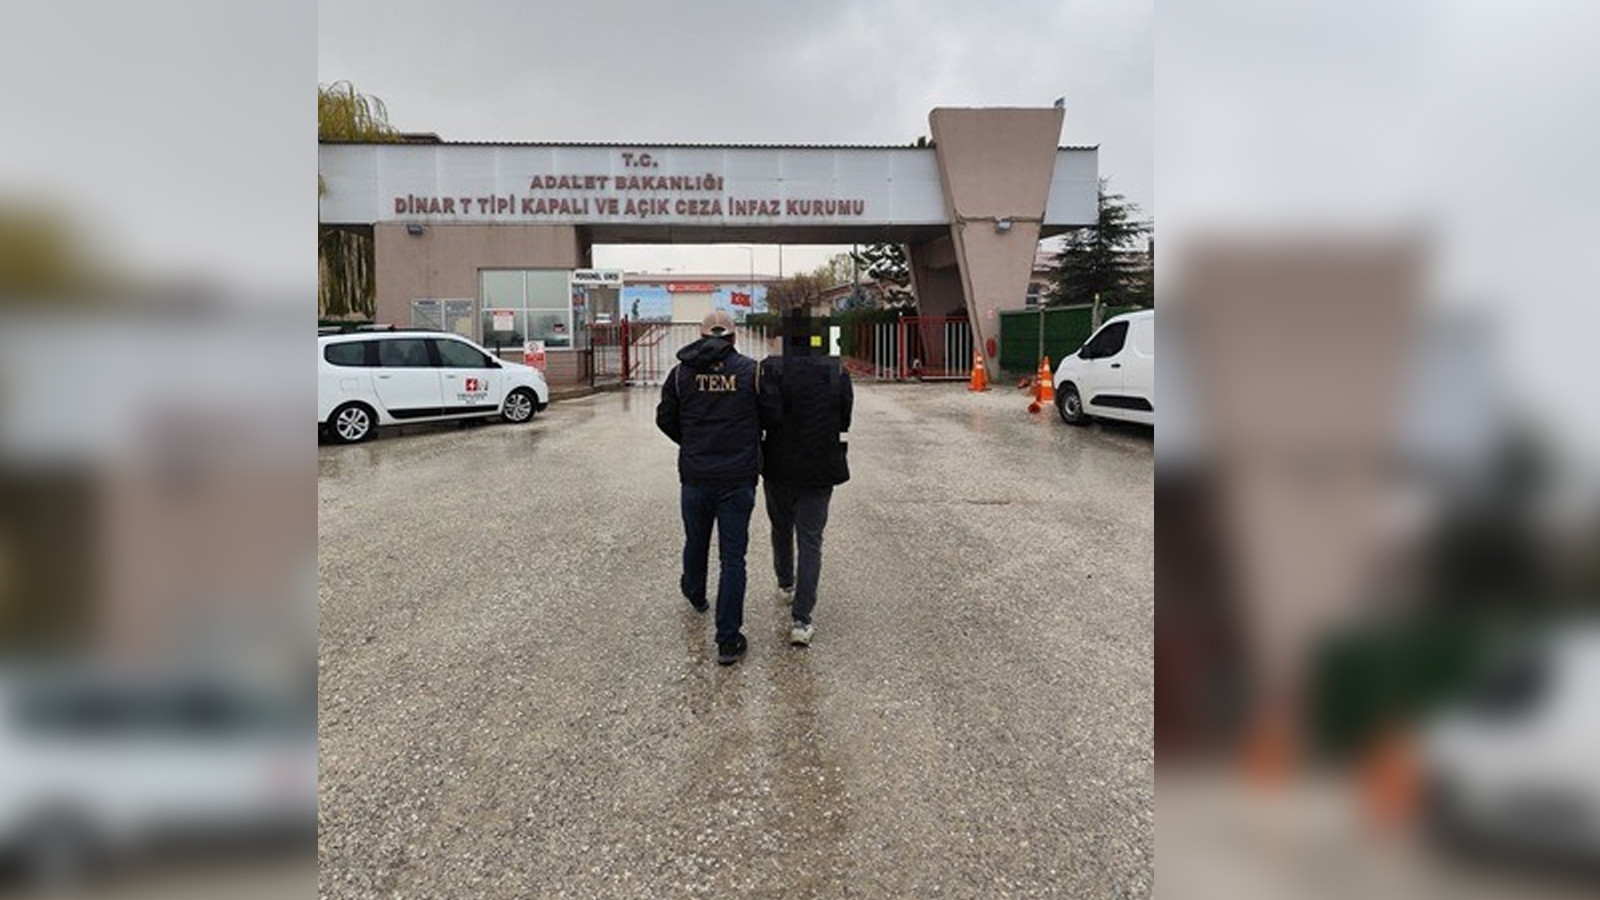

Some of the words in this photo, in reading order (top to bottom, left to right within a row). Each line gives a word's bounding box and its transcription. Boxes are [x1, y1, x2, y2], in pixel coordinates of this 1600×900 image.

[622, 153, 658, 168] T.C.
[530, 175, 609, 190] ADALET
[615, 173, 724, 191] BAKANLIĞI
[394, 194, 455, 215] DİNAR
[459, 198, 472, 215] T
[477, 194, 515, 215] TİPİ
[521, 198, 588, 215] KAPALI
[594, 198, 619, 215] VE
[624, 198, 670, 218] AÇIK
[675, 199, 724, 216] CEZA
[729, 197, 781, 216] İNFAZ
[786, 199, 865, 216] KURUMU
[695, 374, 736, 391] TEM
